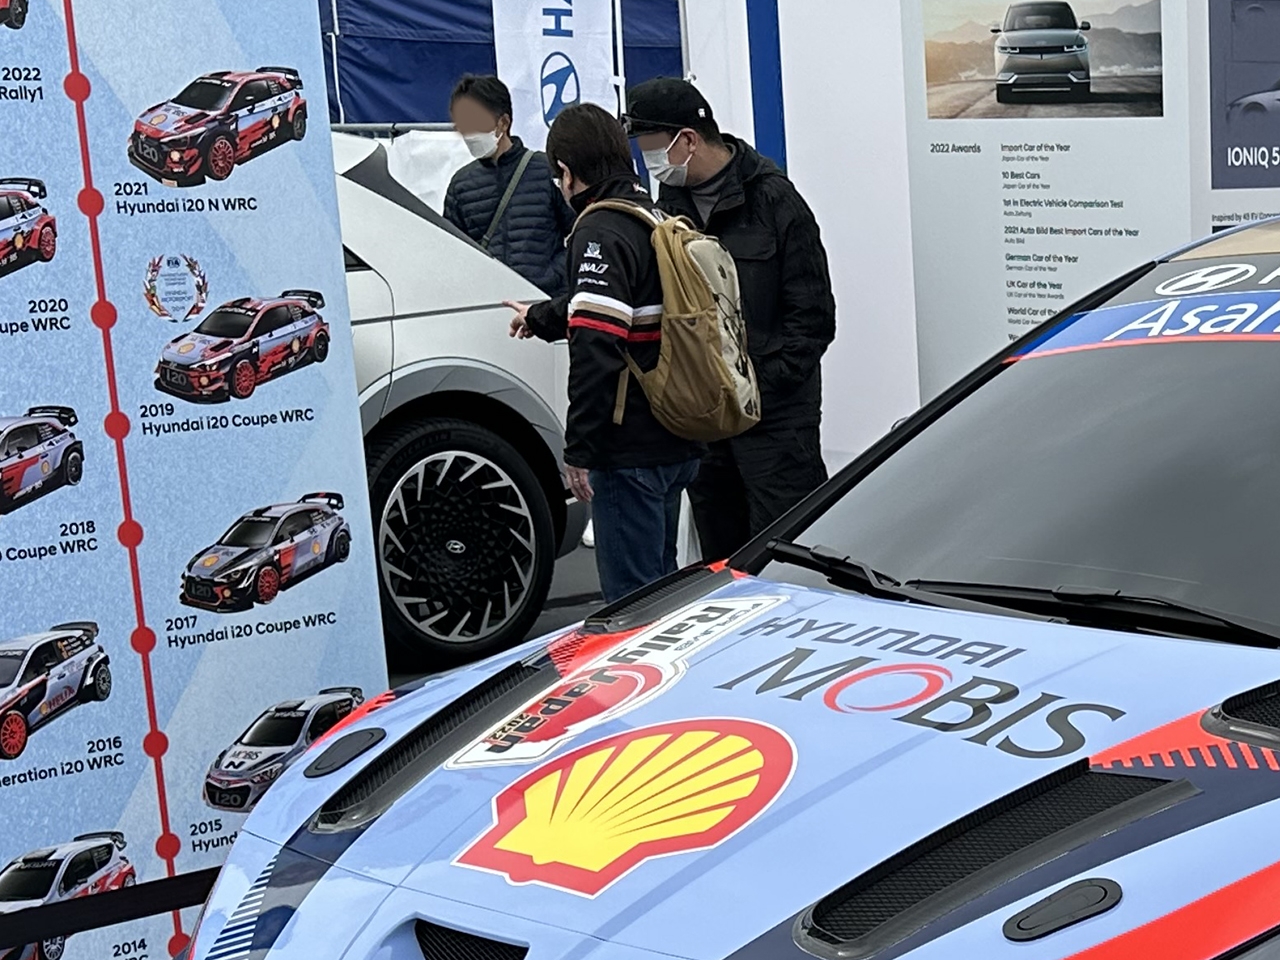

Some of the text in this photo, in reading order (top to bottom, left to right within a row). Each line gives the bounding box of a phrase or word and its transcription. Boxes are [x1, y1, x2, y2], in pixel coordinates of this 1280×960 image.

[1, 67, 42, 82] 2022
[0, 86, 44, 105] Rally1
[930, 143, 981, 153] 2022 Awards
[1000, 143, 1071, 153] Import Car of the Year
[1227, 146, 1269, 169] IONIQ
[1001, 171, 1041, 180] 10 Best Cars
[113, 182, 149, 197] 2021
[116, 197, 258, 216] Hyundai i20 N WRC
[1019, 199, 1043, 208] Electric
[1044, 199, 1067, 208] Vehicle
[1068, 199, 1109, 209] Comparison
[1109, 200, 1124, 208] Test
[1211, 213, 1234, 223] Inspired
[1234, 212, 1242, 223] by
[1004, 226, 1019, 234] 2021
[1019, 227, 1035, 235] Auto
[1049, 227, 1064, 235] Best
[1064, 227, 1087, 237] Import
[1088, 228, 1103, 236] Cars
[1103, 228, 1111, 236] of
[1112, 228, 1123, 236] the
[1124, 228, 1139, 237] Year
[1005, 253, 1078, 263] German Car of the Year
[1006, 280, 1062, 289] UK Car of the Year
[28, 299, 69, 314] 2020
[1007, 307, 1027, 315] World
[1027, 308, 1039, 316] Car
[1040, 308, 1047, 316] of
[31, 316, 71, 332] WRC
[139, 403, 175, 418] 2019
[142, 408, 315, 436] Hyundai i20 Coupe WRC
[59, 520, 96, 537] 2018
[6, 538, 99, 562] Coupe WRC
[165, 615, 198, 632] 2017
[166, 611, 337, 648] Hyundai i20 Coupe WRC
[740, 615, 1026, 669] HYUNDAI
[484, 605, 736, 753] Rally Japan
[715, 646, 1127, 760] MOBIS
[87, 736, 123, 754] 2016
[60, 760, 84, 776] i20
[87, 753, 125, 770] WRC
[189, 818, 223, 837] 2015
[112, 938, 148, 957] 2014
